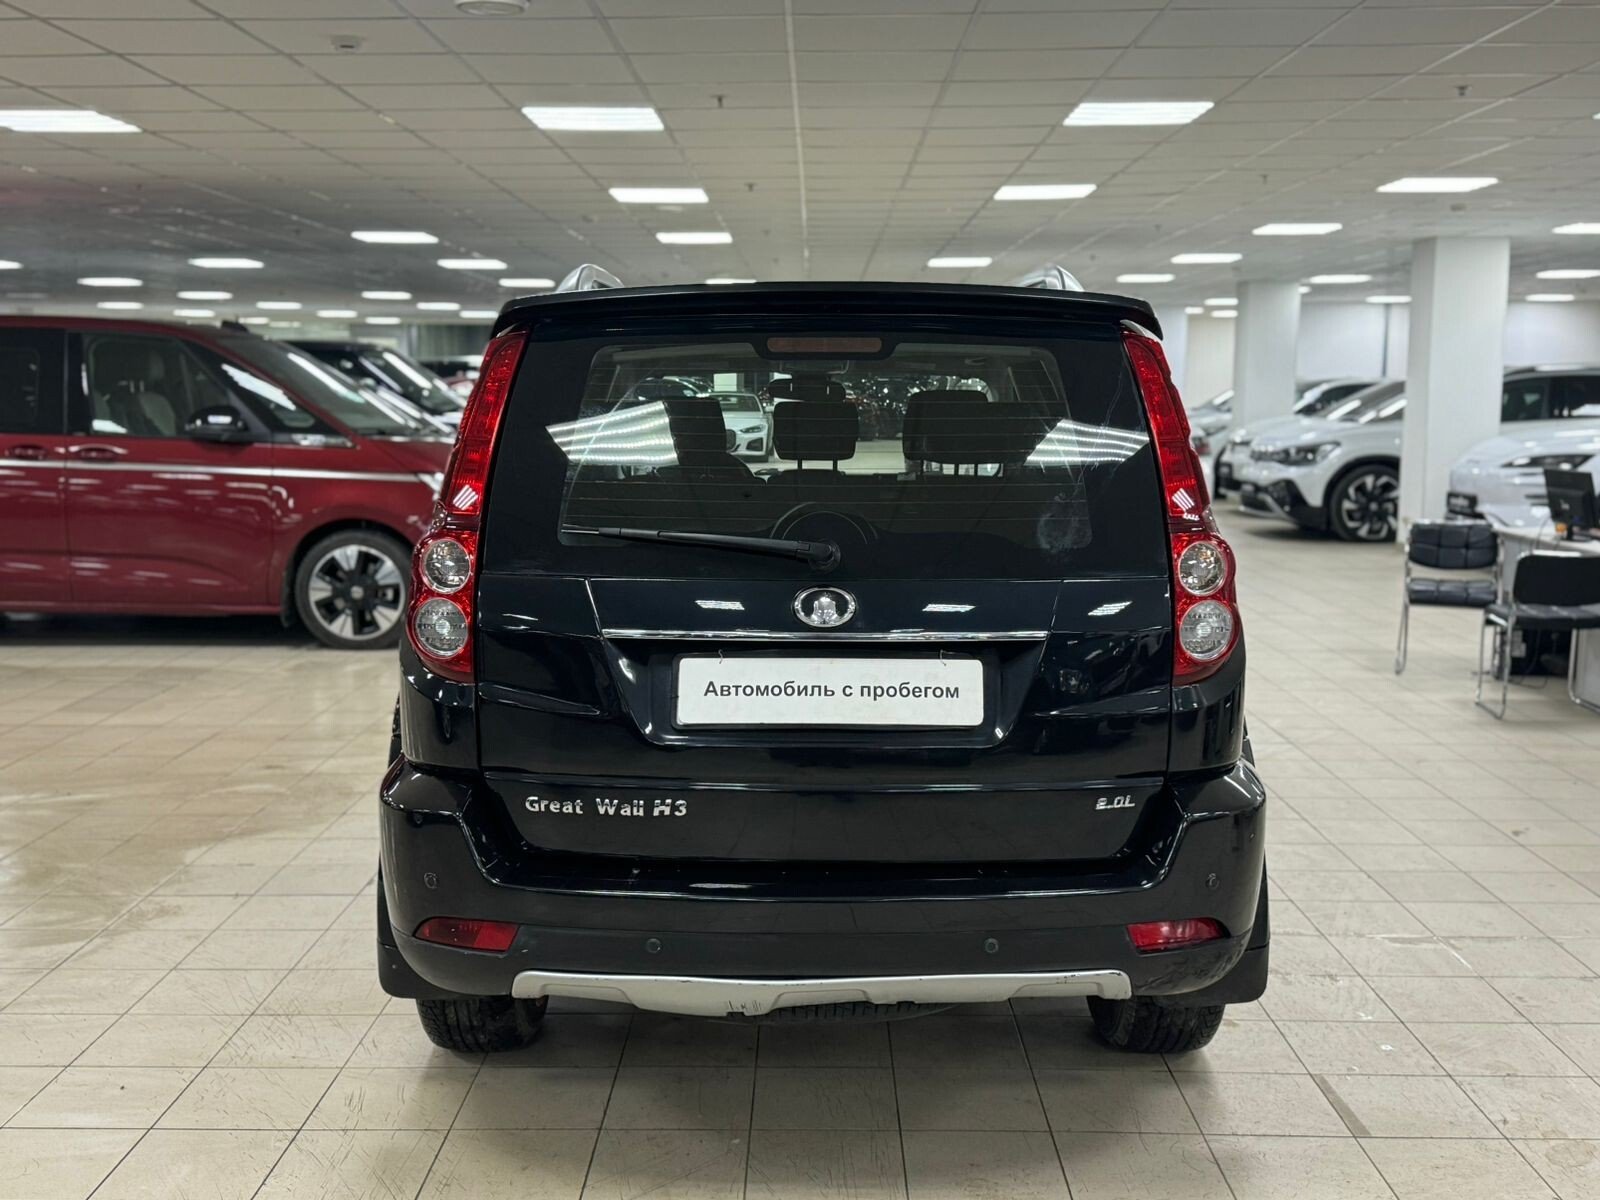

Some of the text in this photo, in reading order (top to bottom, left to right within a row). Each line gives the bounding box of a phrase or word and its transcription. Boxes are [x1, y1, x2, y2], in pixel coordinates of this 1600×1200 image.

[703, 680, 960, 701] Автомобиль с пробегом
[525, 796, 688, 816] Great Wall H3
